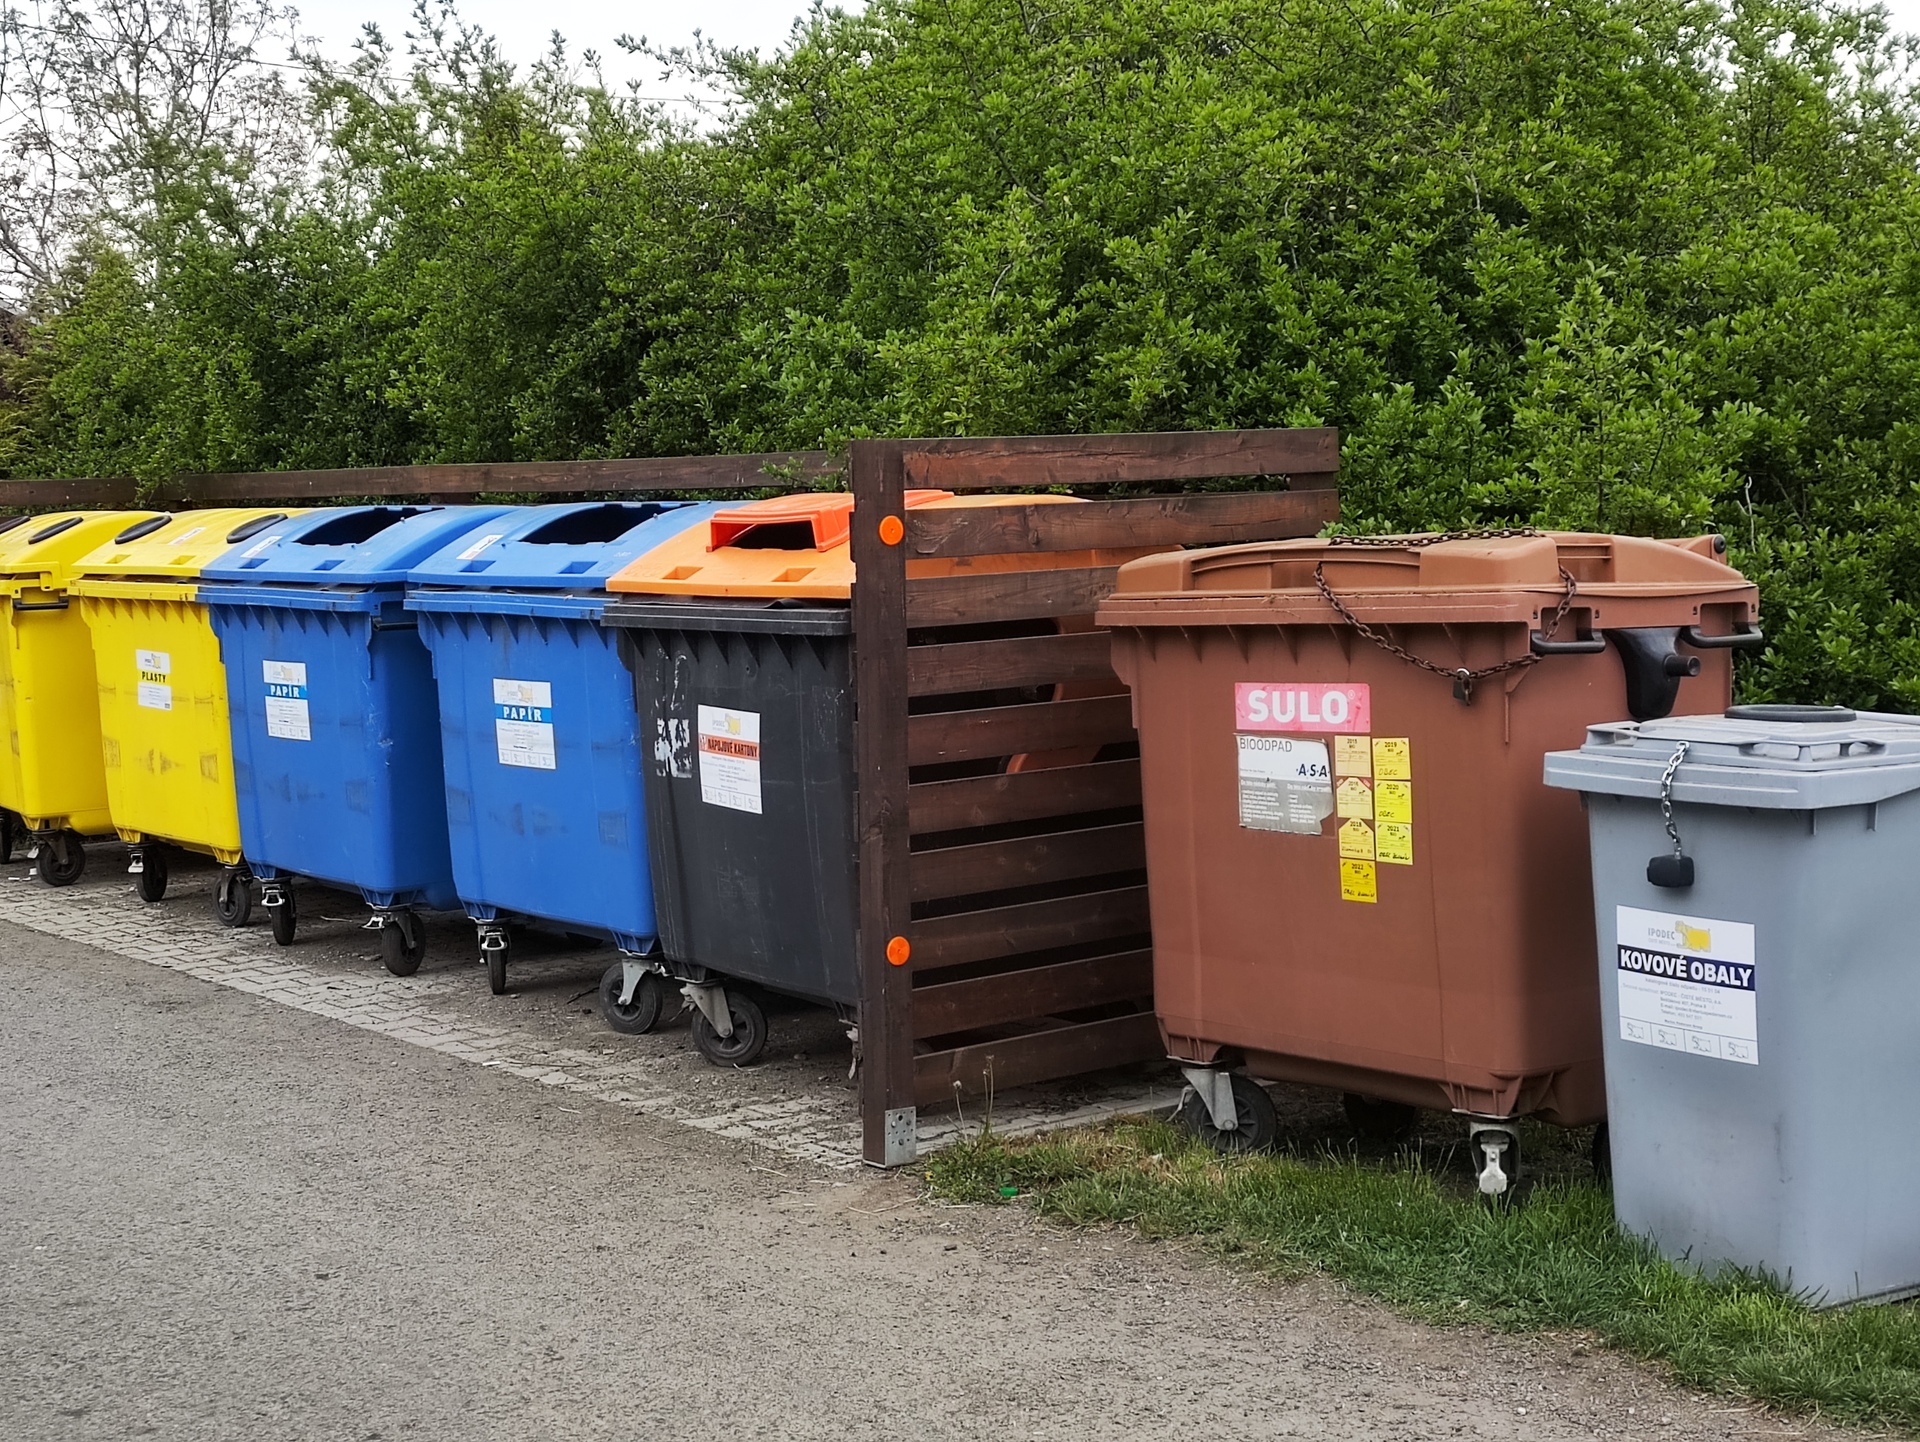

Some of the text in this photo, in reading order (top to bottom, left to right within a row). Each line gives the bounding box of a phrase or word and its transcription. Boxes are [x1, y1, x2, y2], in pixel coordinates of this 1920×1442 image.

[142, 671, 166, 683] PLASTY
[503, 706, 542, 721] PAPÍR
[1248, 689, 1348, 724] SULO
[733, 743, 758, 758] KARTONY
[1240, 738, 1292, 752] BIOODPAD
[1648, 927, 1675, 940] IPODEC
[1620, 949, 1752, 987] KOVOVÉ OBALY
